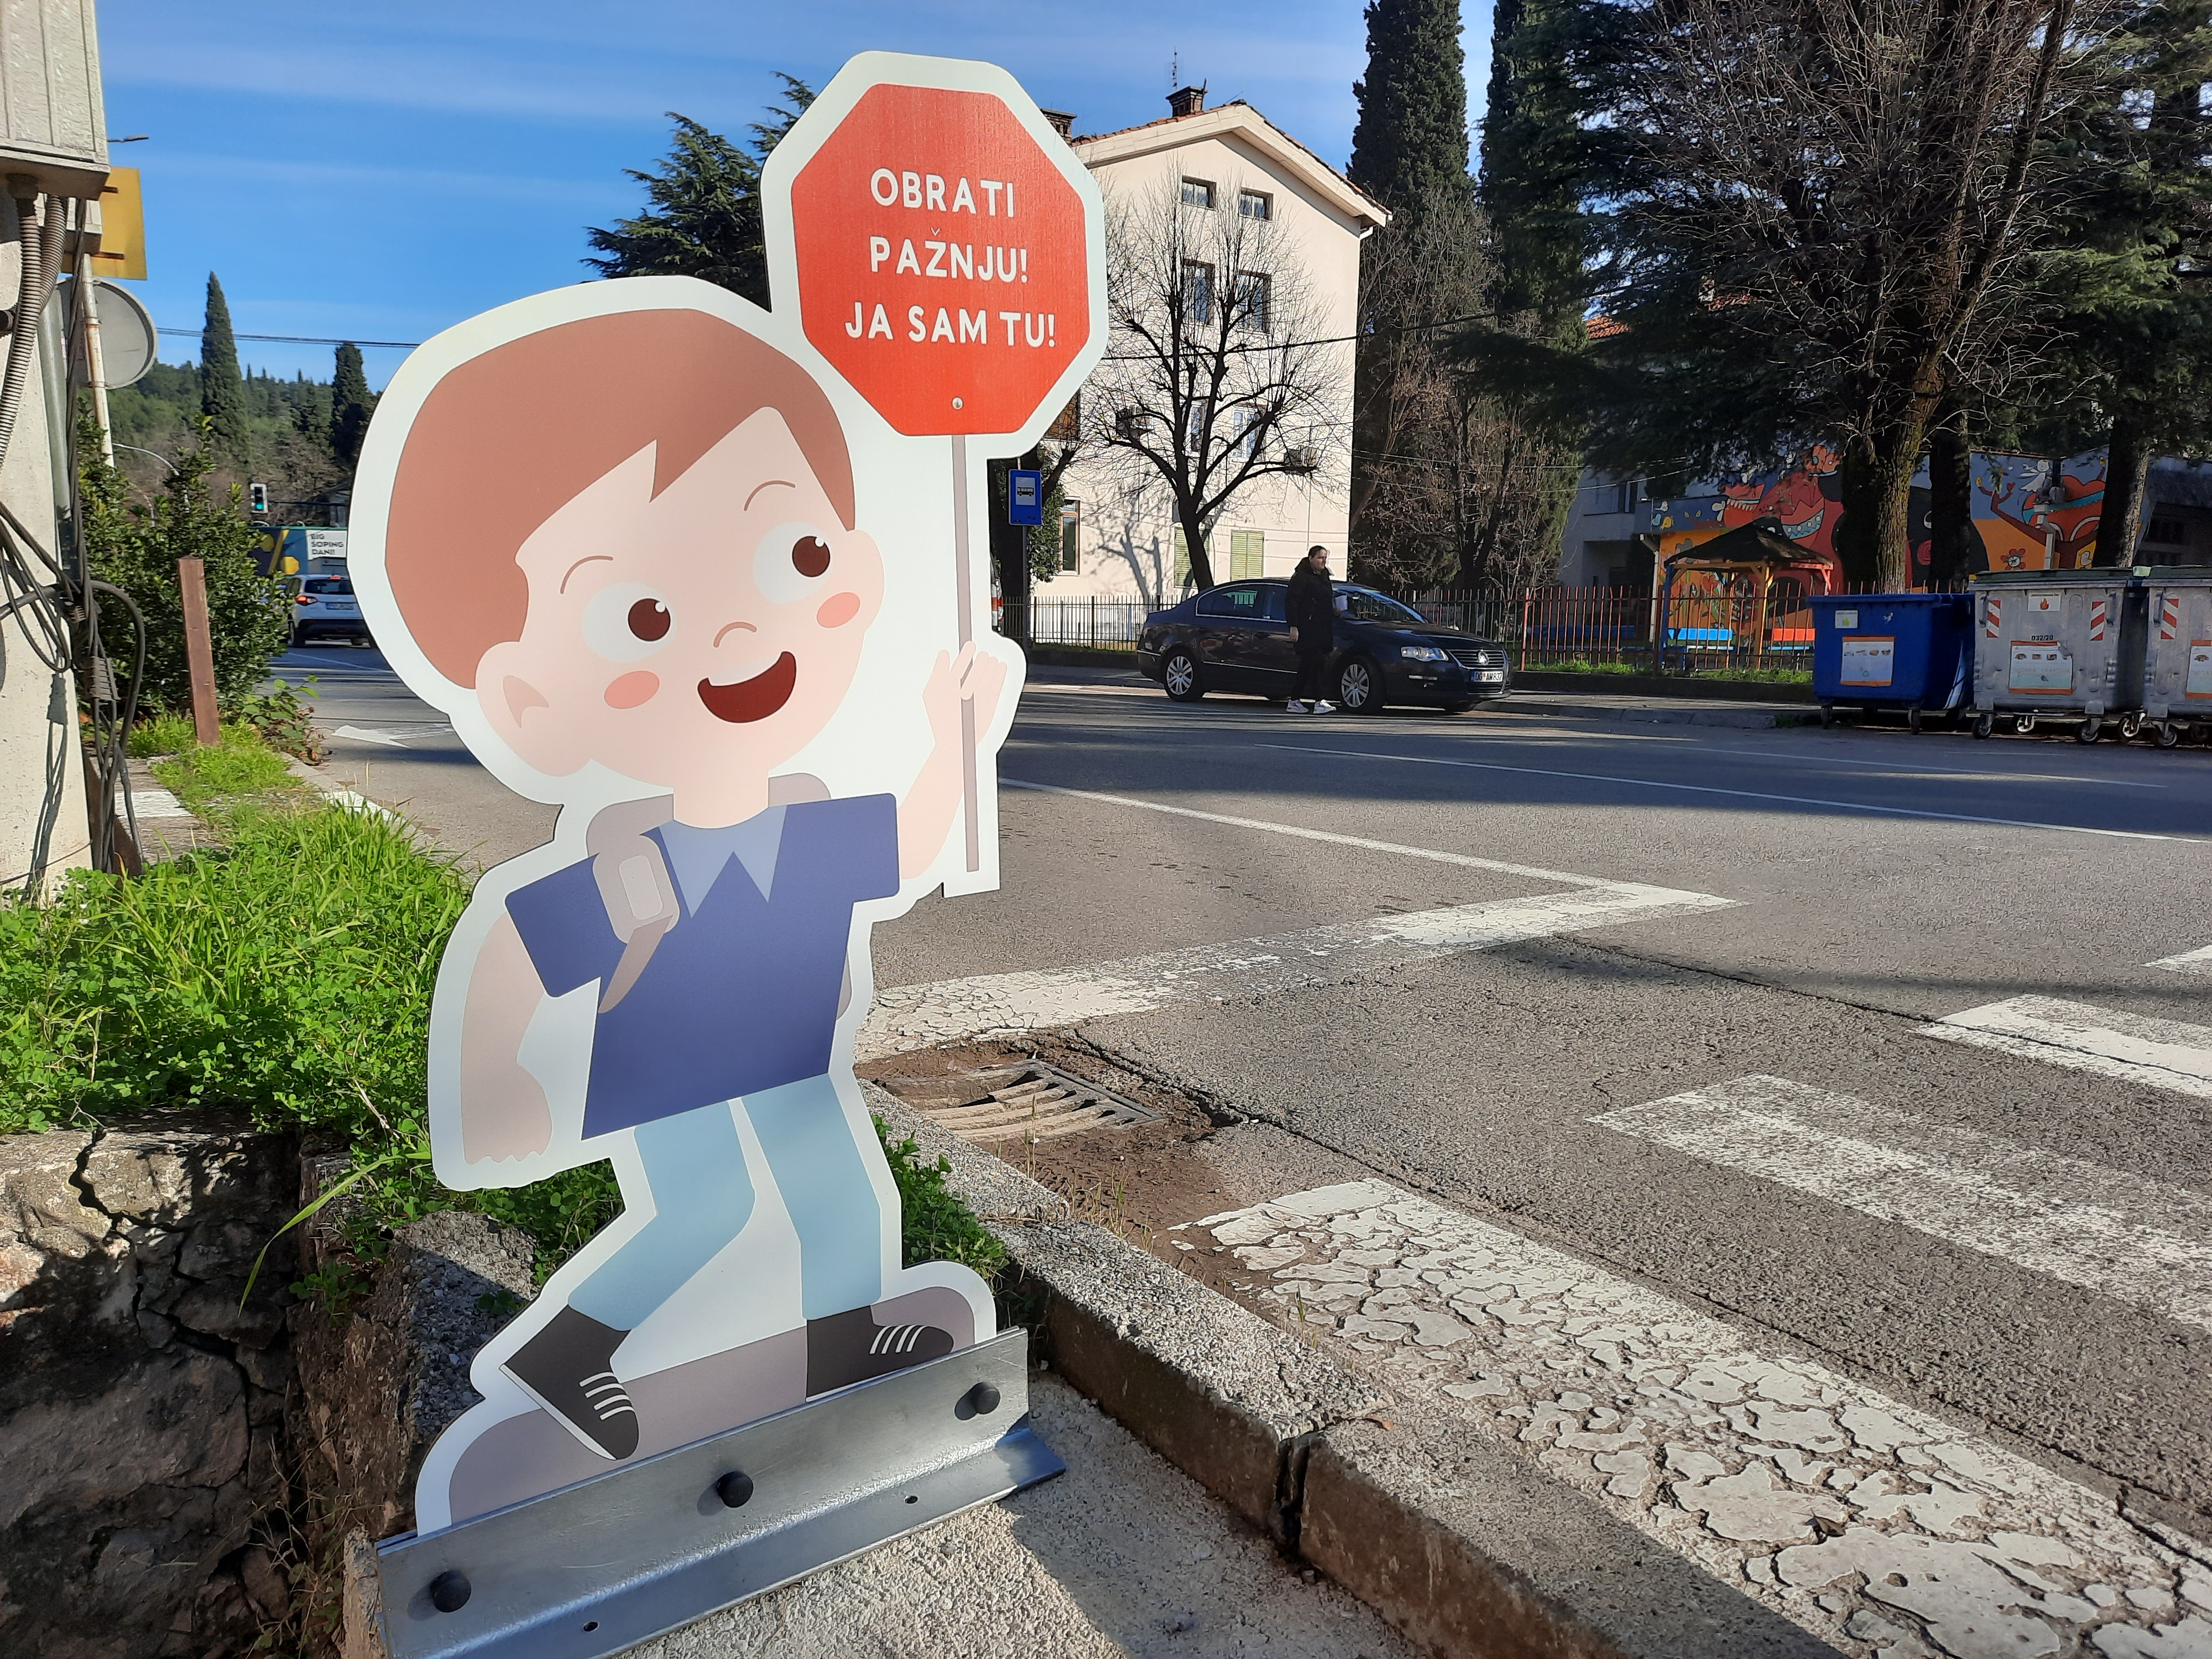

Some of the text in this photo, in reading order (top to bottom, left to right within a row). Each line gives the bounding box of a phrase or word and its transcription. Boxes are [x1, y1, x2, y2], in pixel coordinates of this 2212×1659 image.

[870, 168, 1014, 218] OBRATI
[870, 227, 1027, 284] PAŽNJU!
[844, 301, 1056, 348] JA SAM TU!
